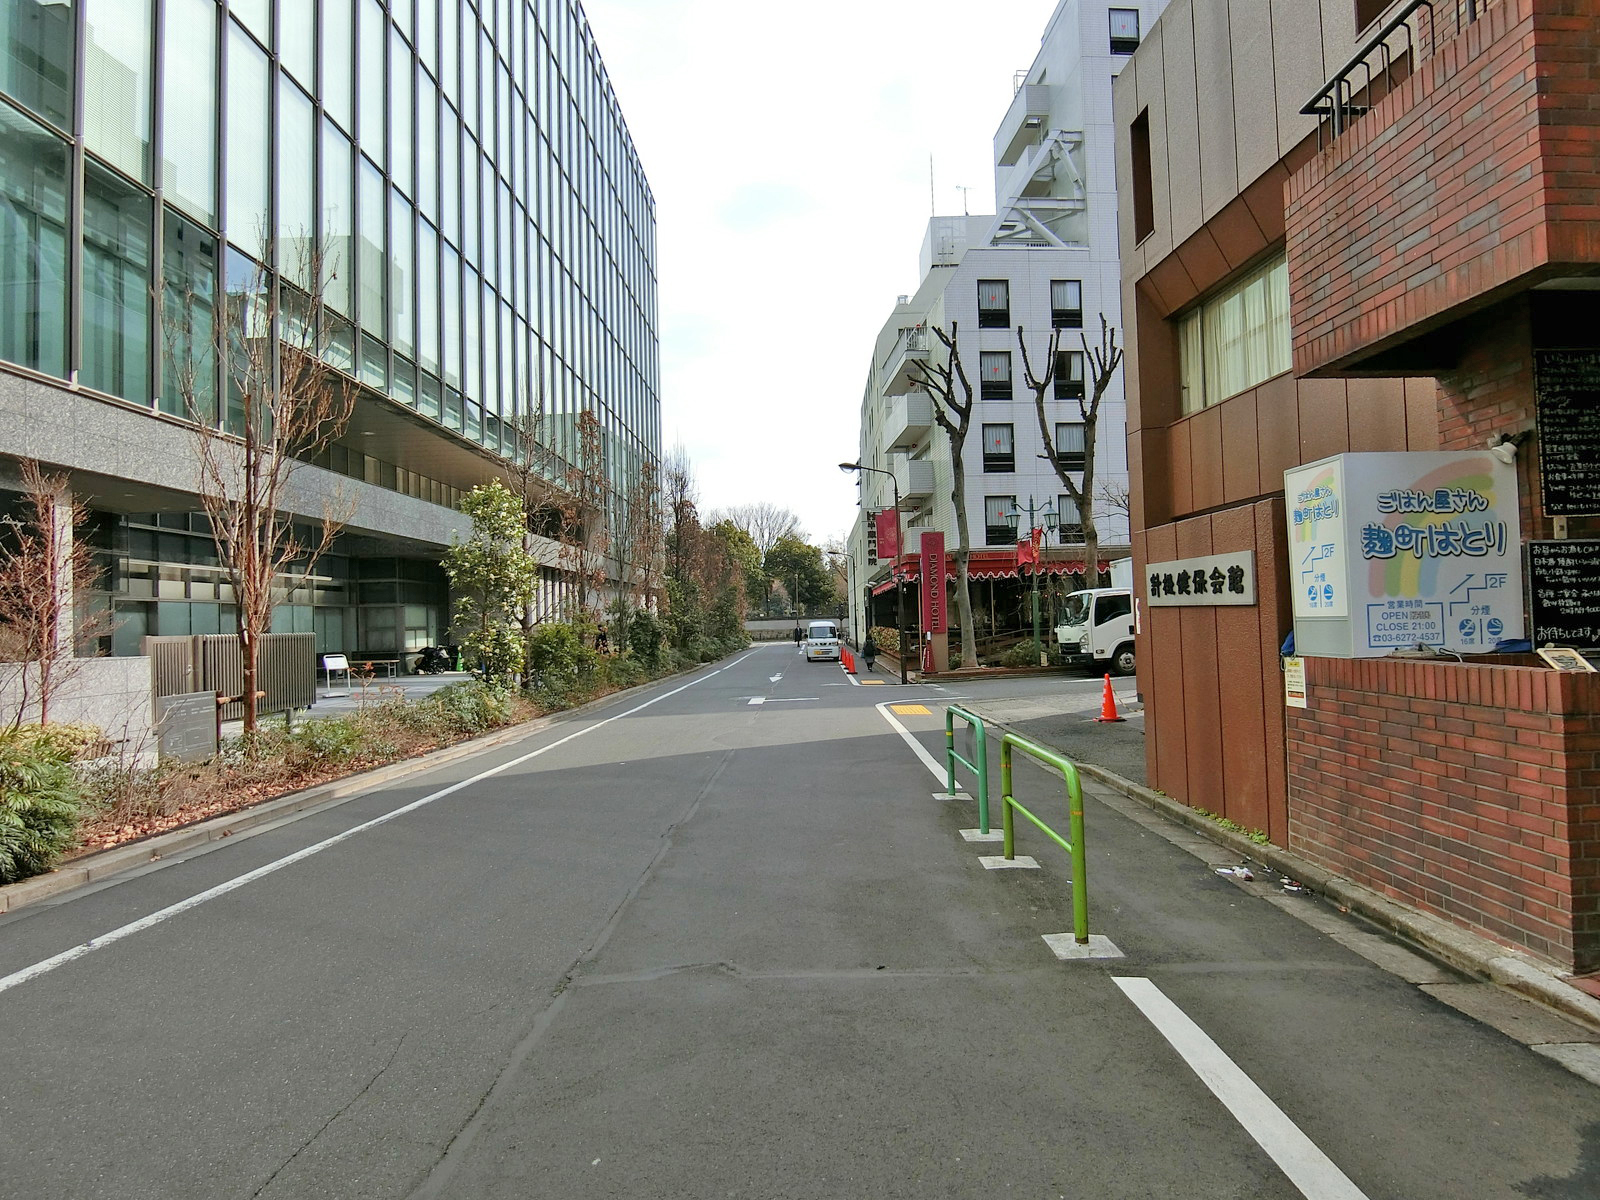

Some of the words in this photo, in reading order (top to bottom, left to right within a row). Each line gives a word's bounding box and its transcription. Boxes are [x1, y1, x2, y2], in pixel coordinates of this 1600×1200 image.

[1297, 485, 1333, 503] ごはん屋さん
[1377, 487, 1489, 514] ごはん屋さん
[1324, 546, 1335, 558] 2F
[929, 553, 939, 598] DIAMOND
[1489, 577, 1506, 588] 2F
[1387, 600, 1423, 609] 営業時間
[1471, 605, 1491, 615] 分煙
[931, 601, 940, 630] HOTEL
[1381, 611, 1408, 620] OPEN
[1376, 622, 1409, 631] CLOSE
[1411, 621, 1436, 630] 21:00
[1382, 632, 1440, 642] 03-6272-4537
[1536, 625, 1592, 641] お待ちしてます
